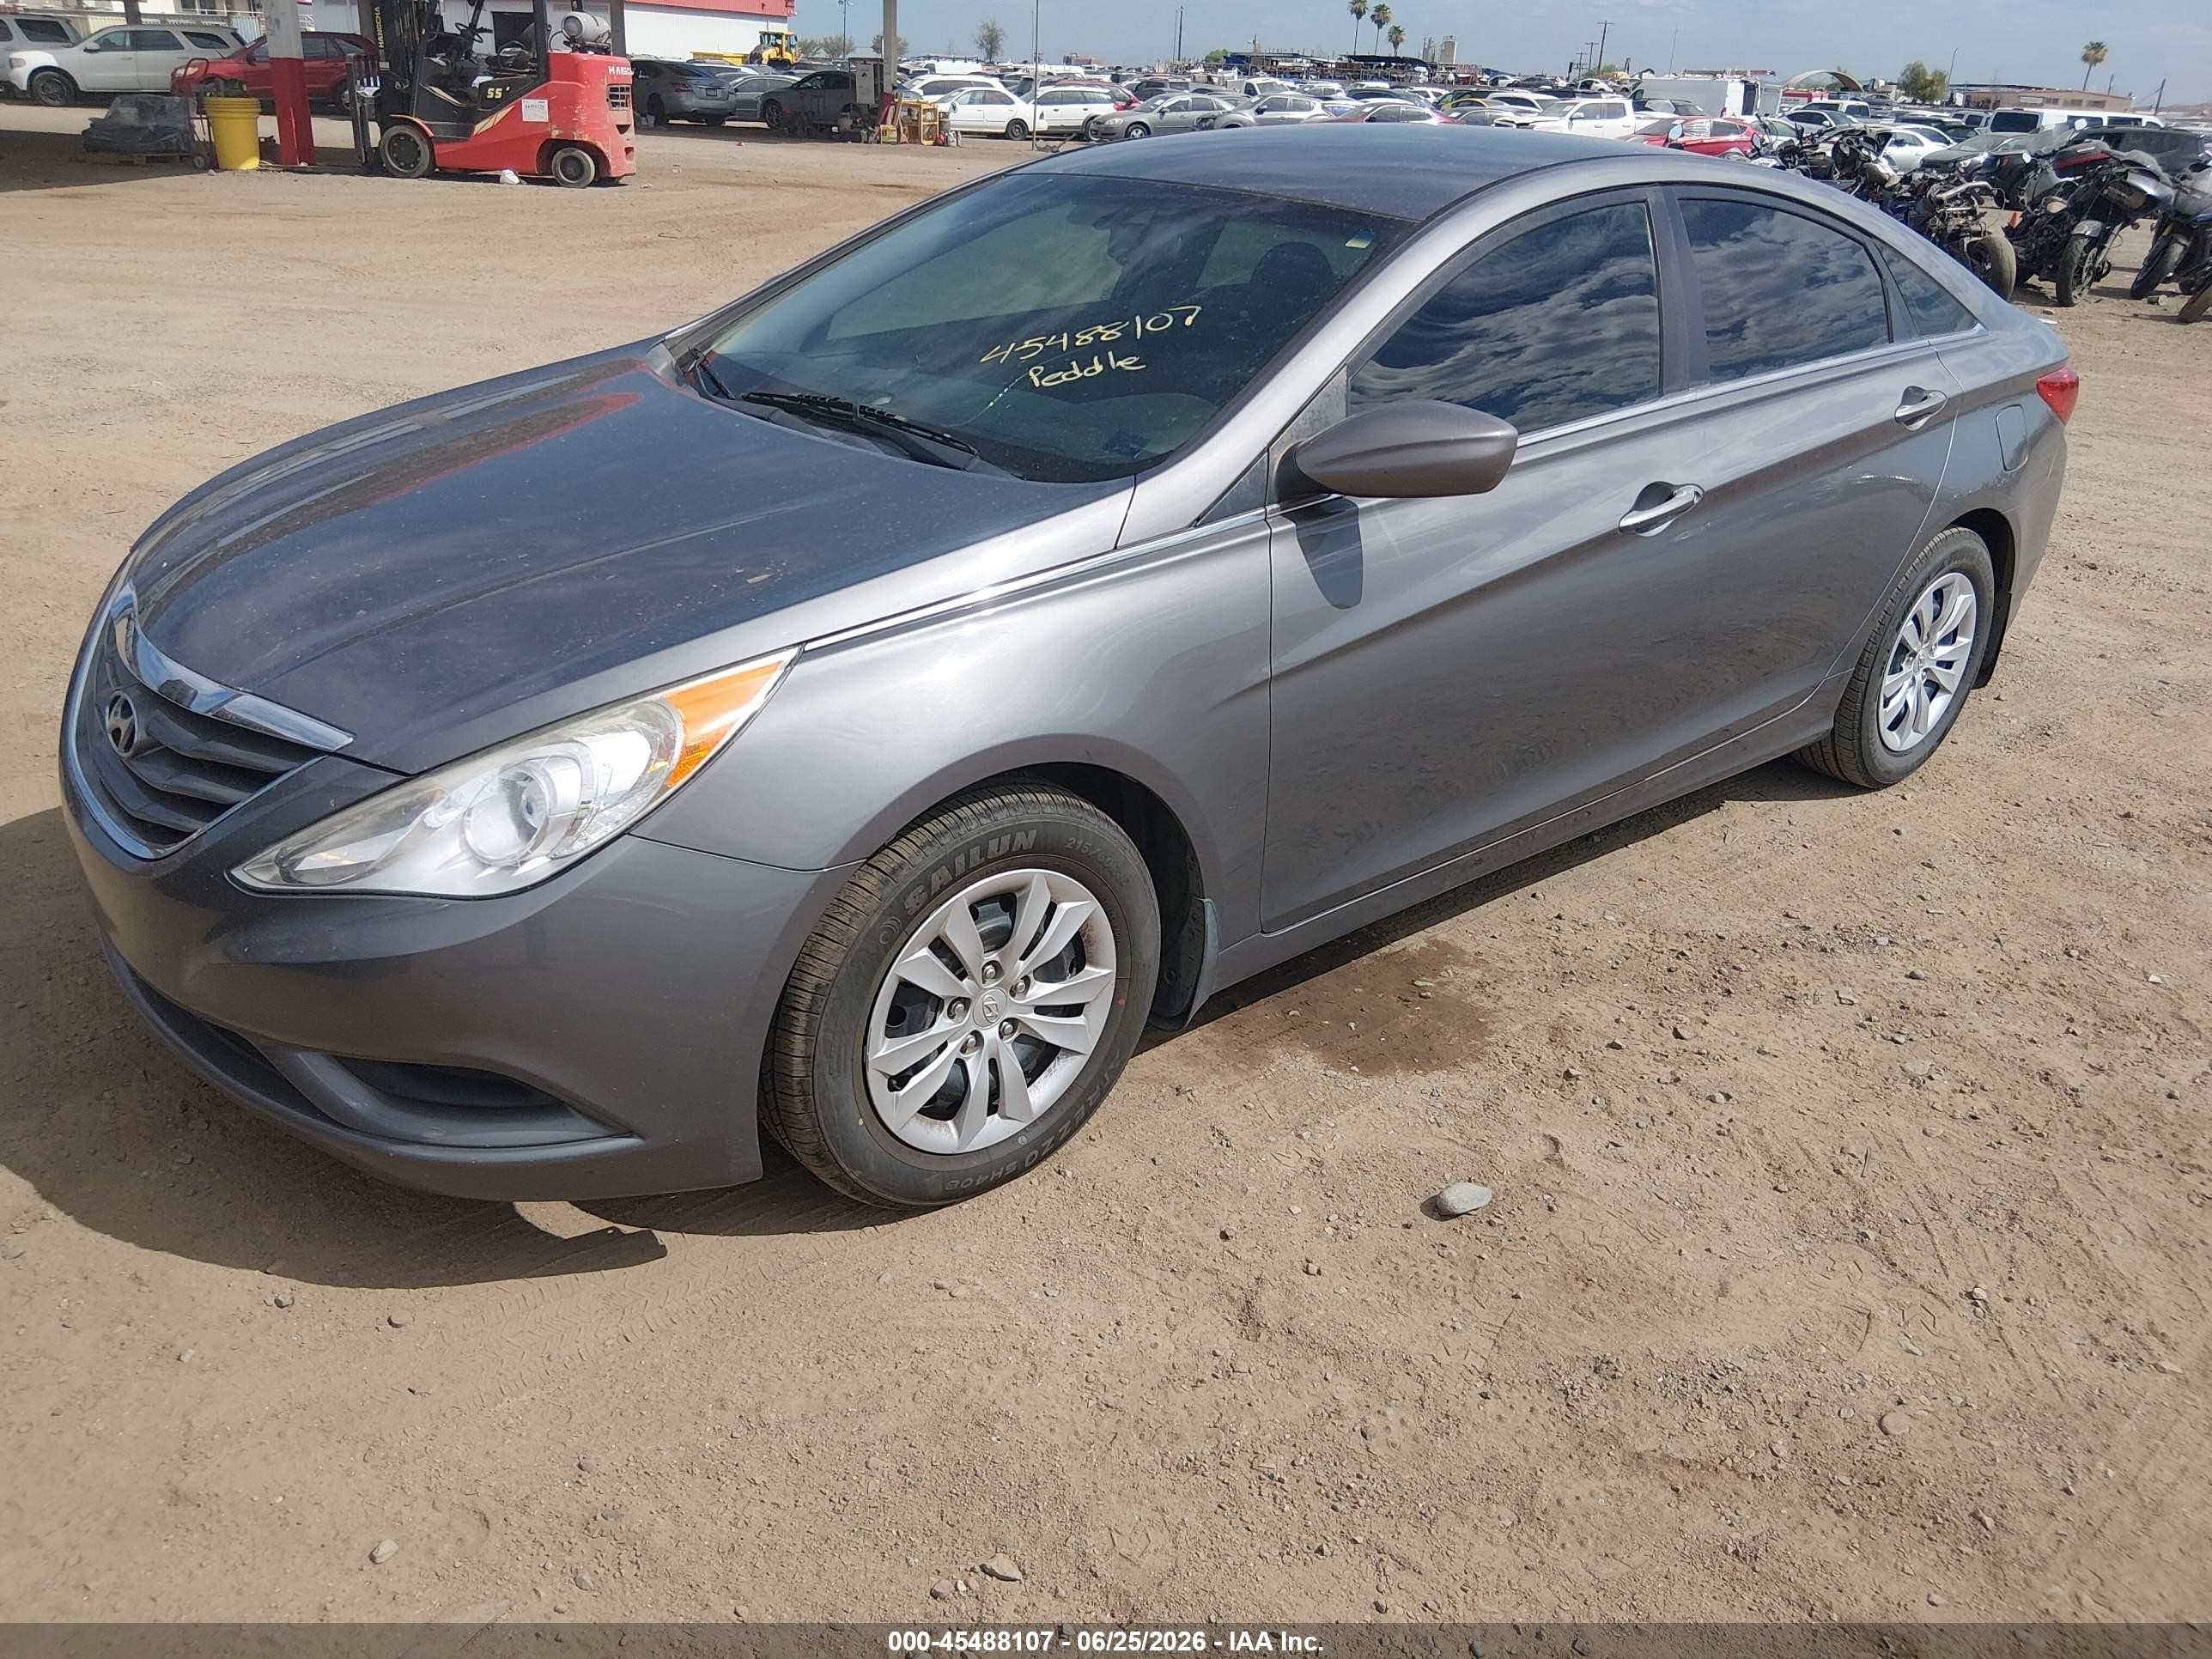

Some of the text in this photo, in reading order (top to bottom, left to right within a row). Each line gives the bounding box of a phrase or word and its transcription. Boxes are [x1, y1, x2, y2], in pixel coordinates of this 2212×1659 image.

[374, 6, 385, 48] HANGCHA
[980, 306, 1202, 363] 45488107
[1029, 350, 1146, 388] Peddle
[904, 830, 1037, 915] SAILUN
